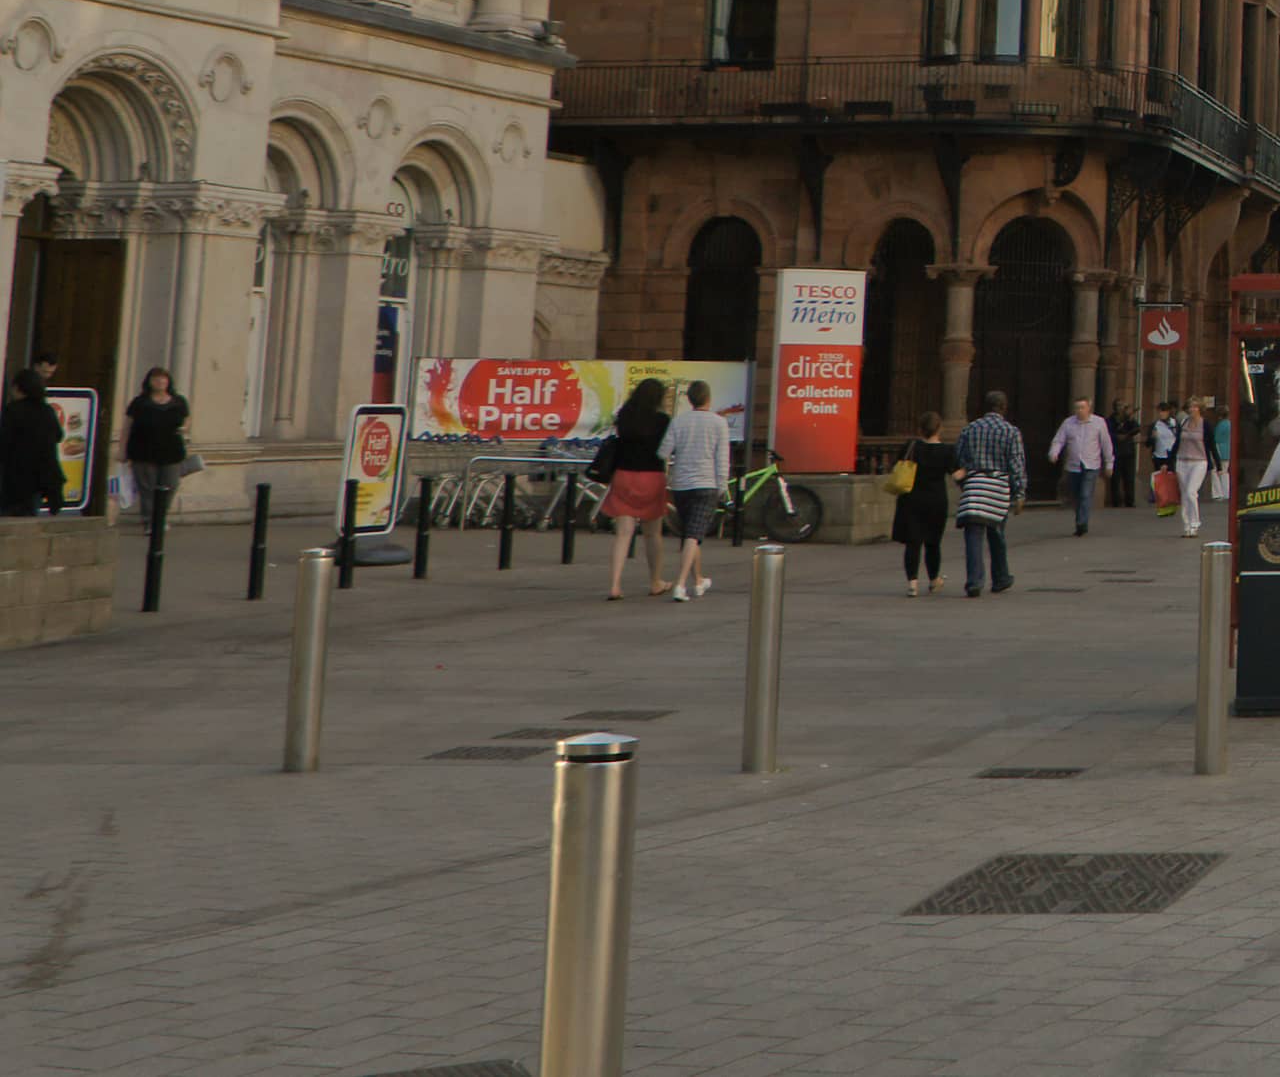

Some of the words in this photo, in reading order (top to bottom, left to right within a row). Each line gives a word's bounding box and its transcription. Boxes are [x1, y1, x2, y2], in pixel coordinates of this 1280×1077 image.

[793, 285, 857, 299] TESCO
[791, 306, 857, 325] Metro
[496, 367, 522, 376] SAVE
[523, 367, 536, 376] UP
[536, 368, 551, 376] TO
[787, 355, 854, 379] direct
[487, 378, 560, 405] Half
[787, 384, 853, 399] Collection
[803, 401, 839, 415] Point
[478, 405, 562, 431] Price
[368, 434, 390, 450] Half
[363, 450, 388, 466] Price
